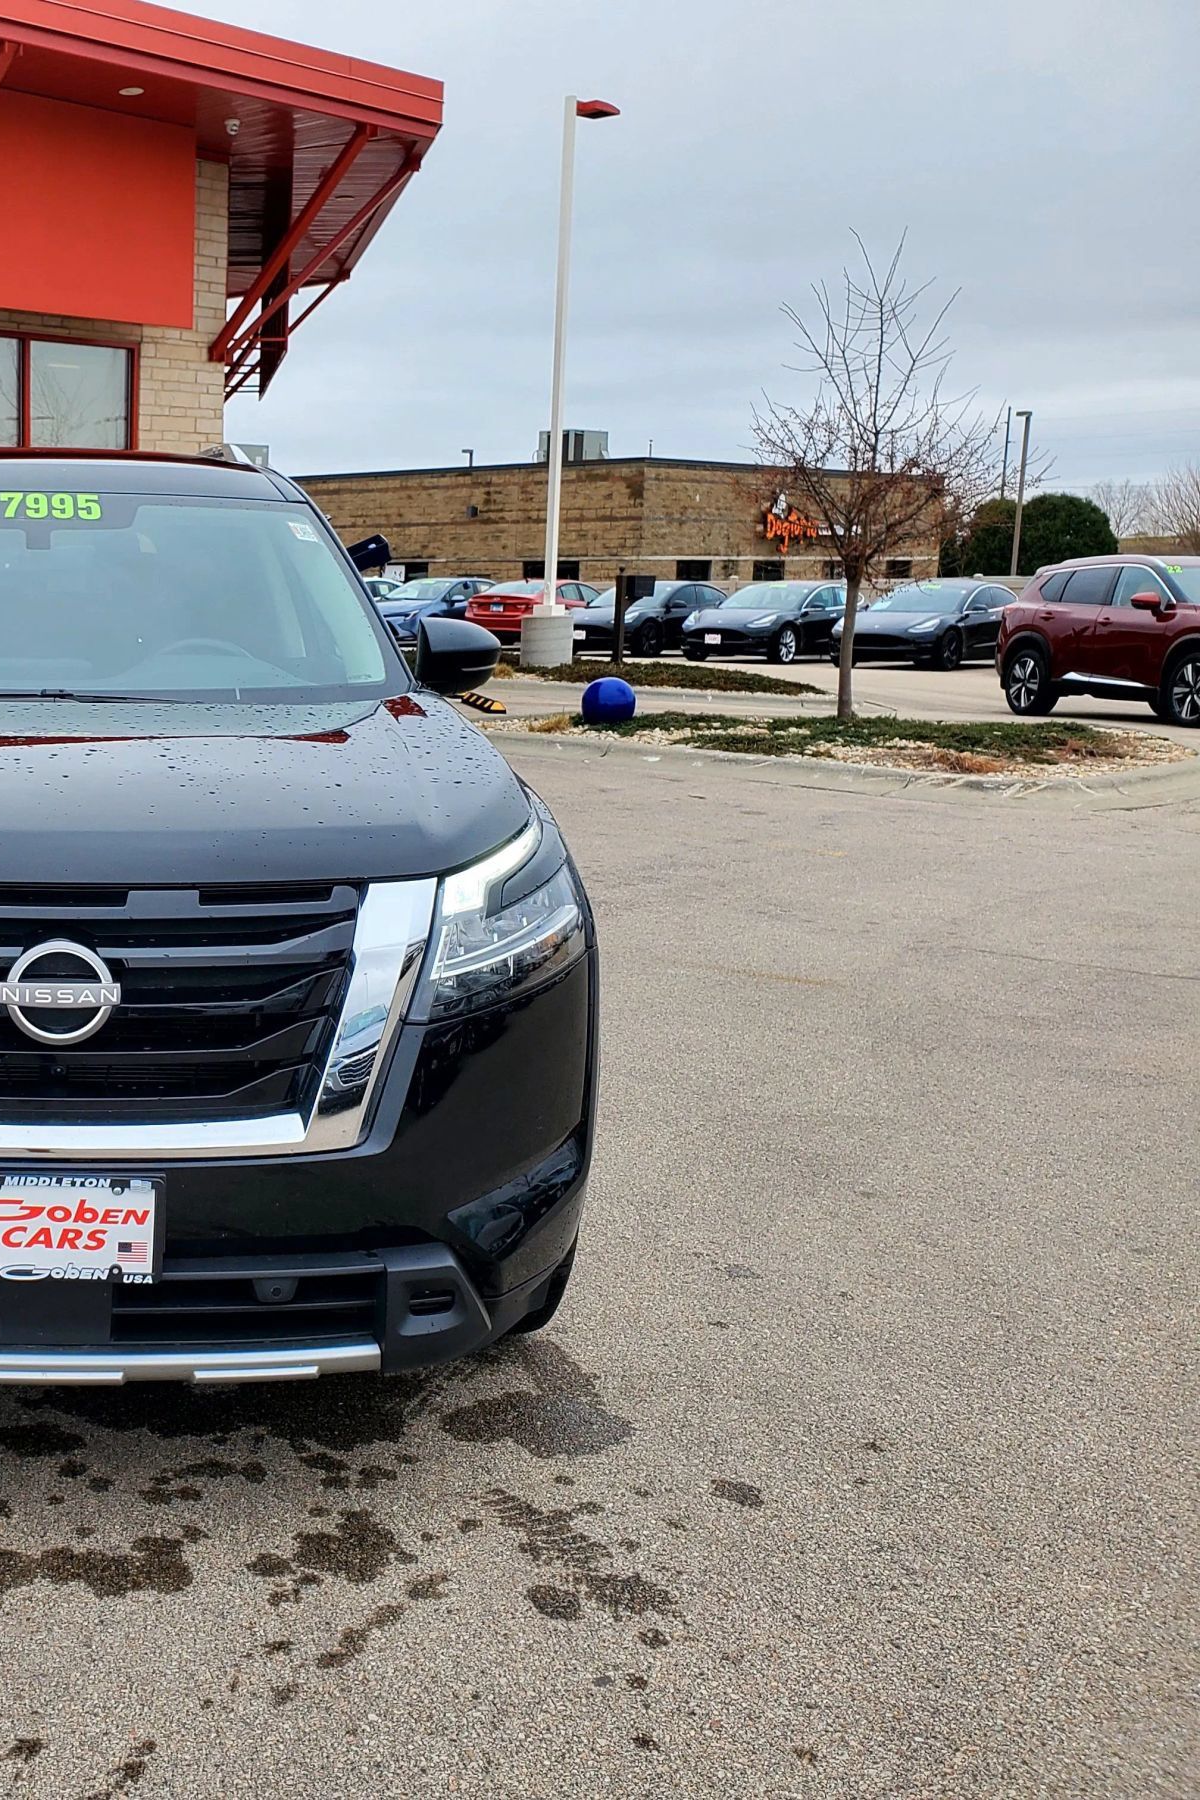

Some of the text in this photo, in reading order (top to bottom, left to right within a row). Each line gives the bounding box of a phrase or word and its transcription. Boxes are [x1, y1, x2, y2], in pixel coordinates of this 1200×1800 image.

[2, 986, 118, 1004] NISSAN
[3, 1175, 112, 1188] MIDDLETON
[1, 1226, 109, 1251] CARS
[122, 1274, 154, 1285] USA
